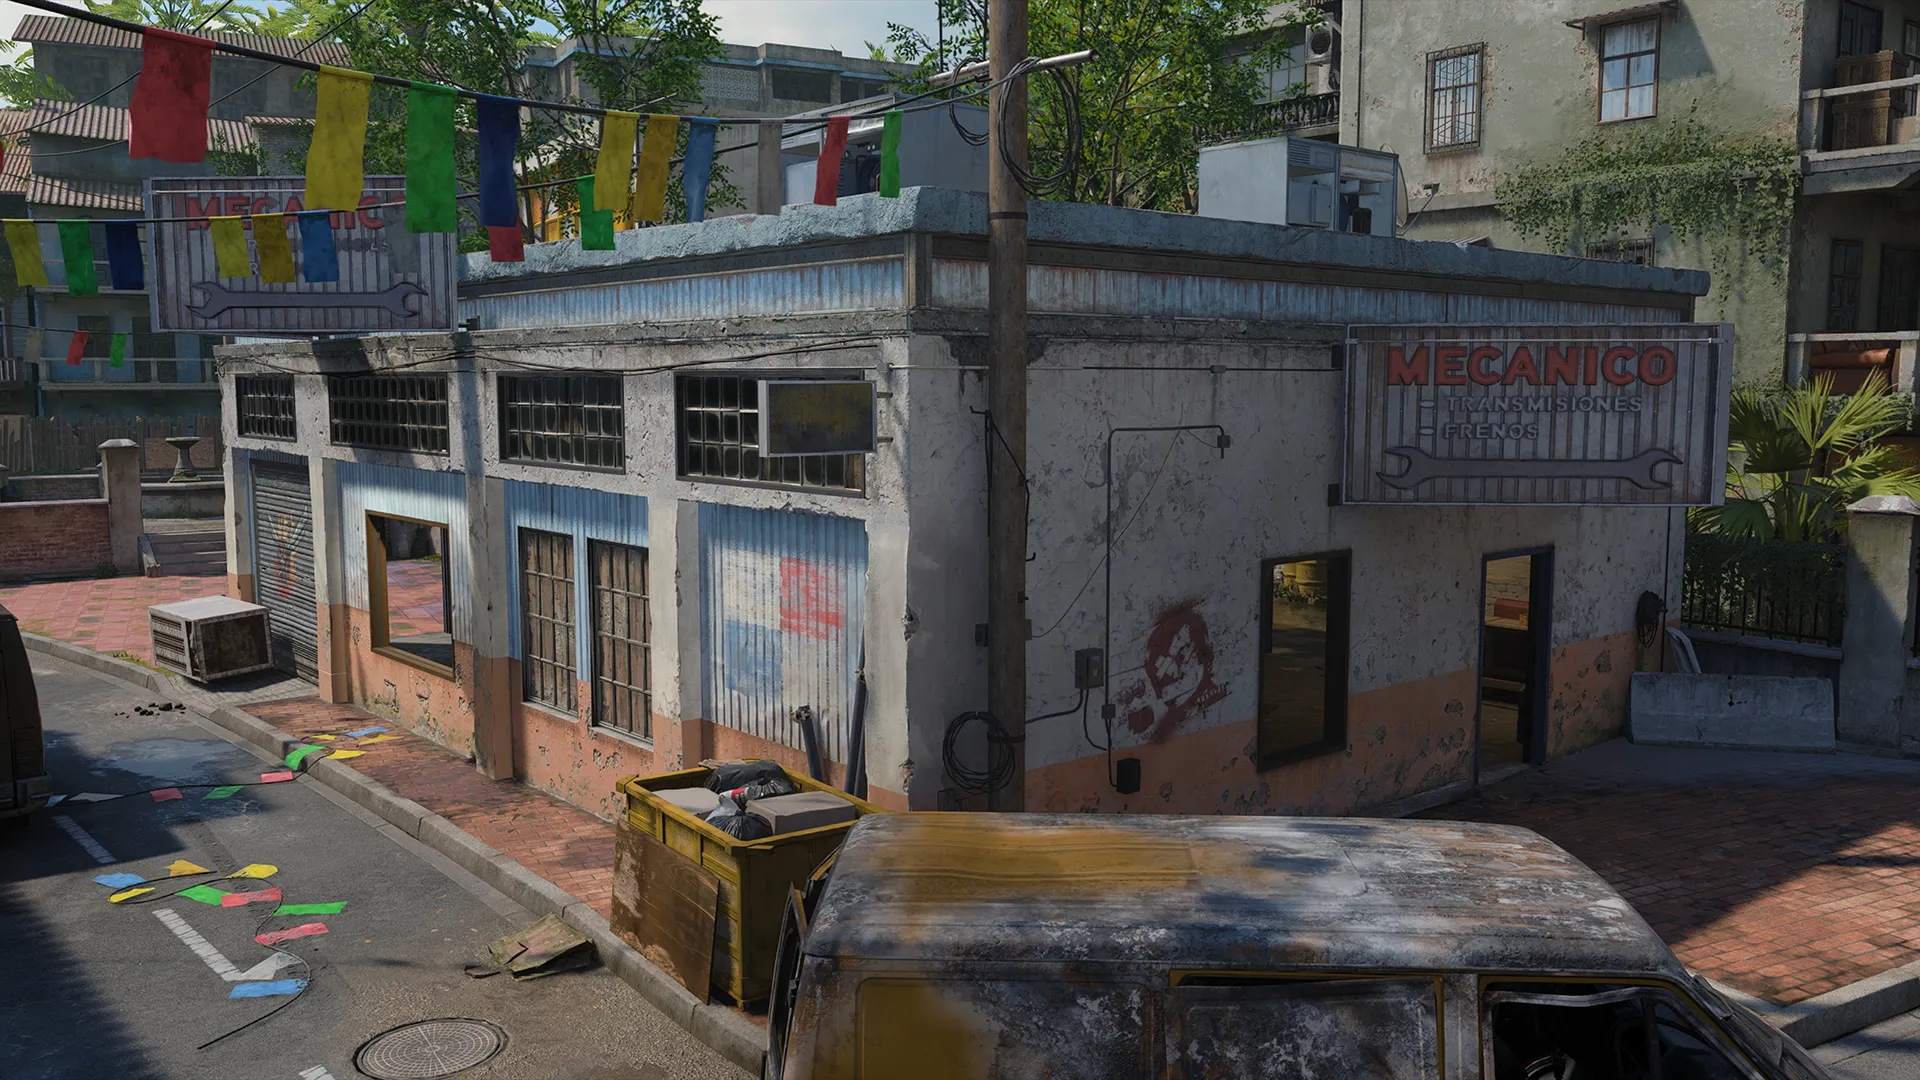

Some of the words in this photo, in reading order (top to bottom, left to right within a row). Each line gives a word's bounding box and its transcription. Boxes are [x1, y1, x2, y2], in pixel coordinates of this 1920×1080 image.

[1387, 346, 1676, 386] MECANICO
[1446, 395, 1642, 412] TRANSMISIONES
[1443, 423, 1539, 440] FRENOS
